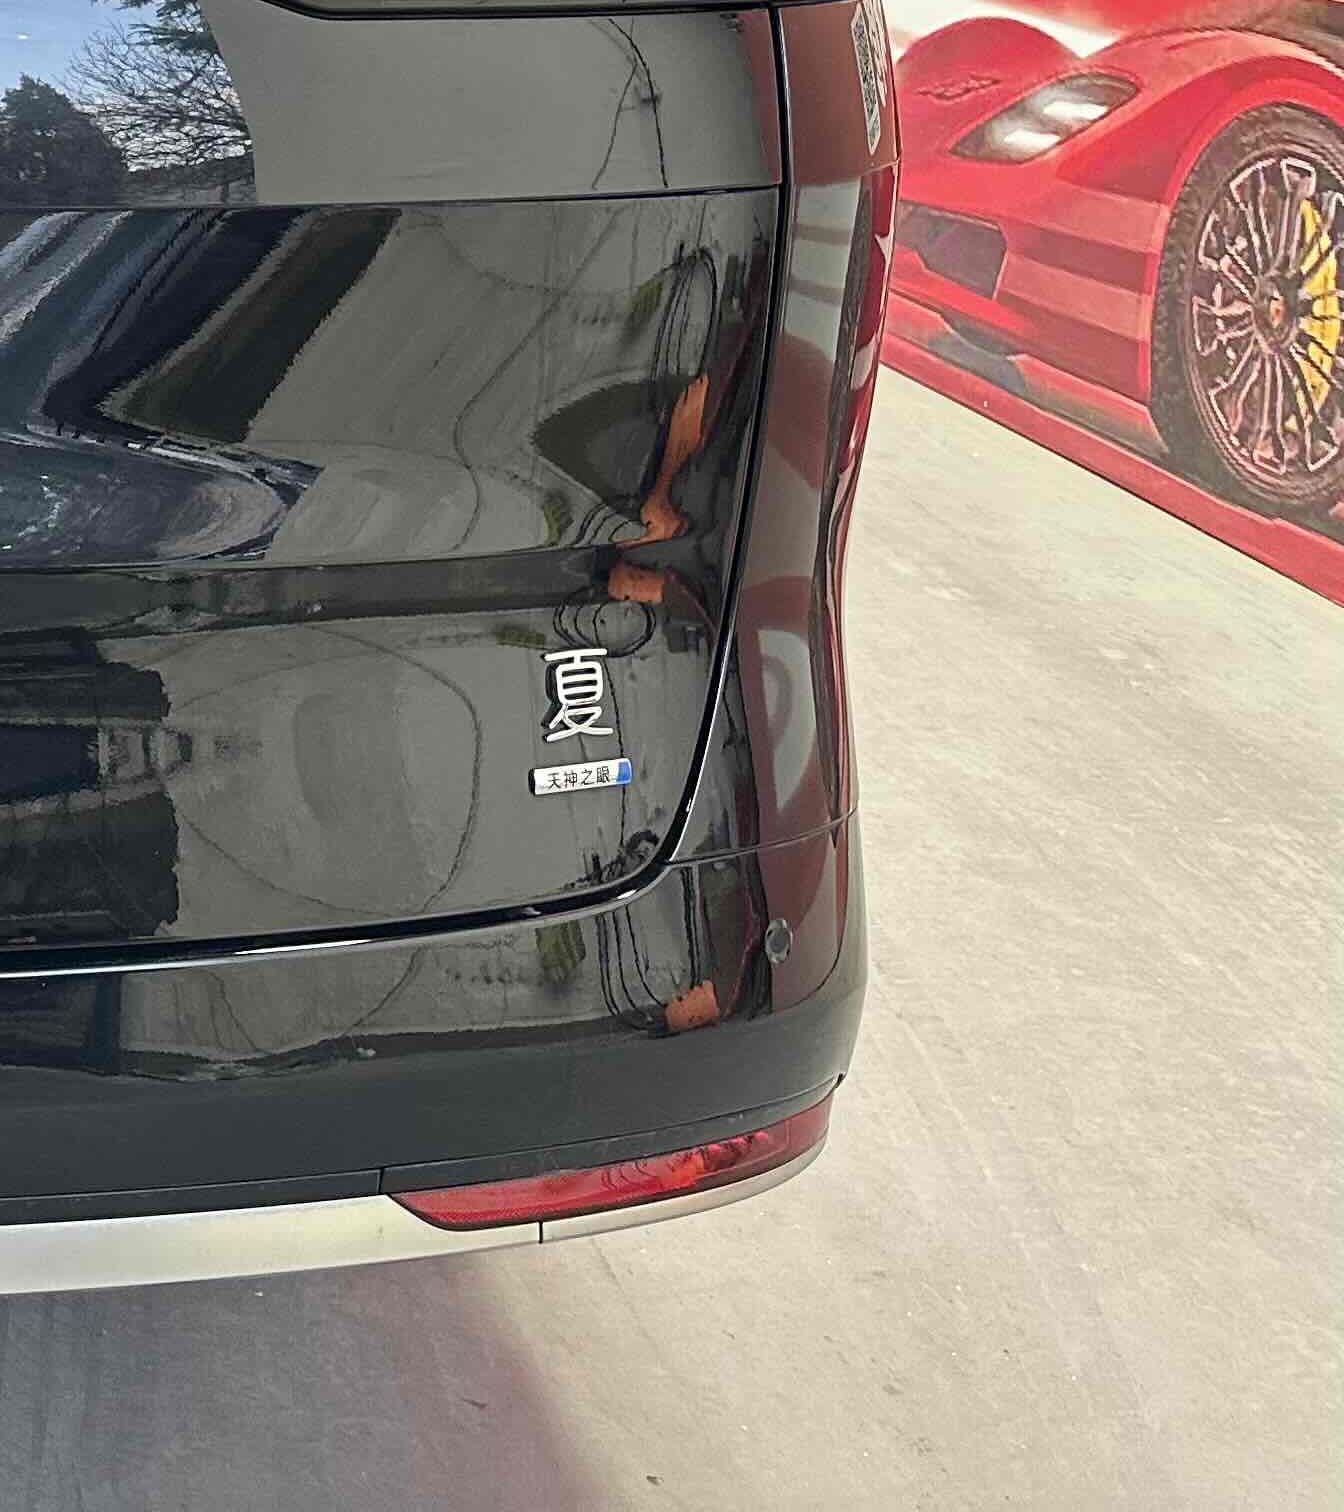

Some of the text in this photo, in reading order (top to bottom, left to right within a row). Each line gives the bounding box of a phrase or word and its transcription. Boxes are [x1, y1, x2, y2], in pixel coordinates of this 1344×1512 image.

[544, 648, 613, 742] 夏
[548, 766, 610, 789] 天神之眼
